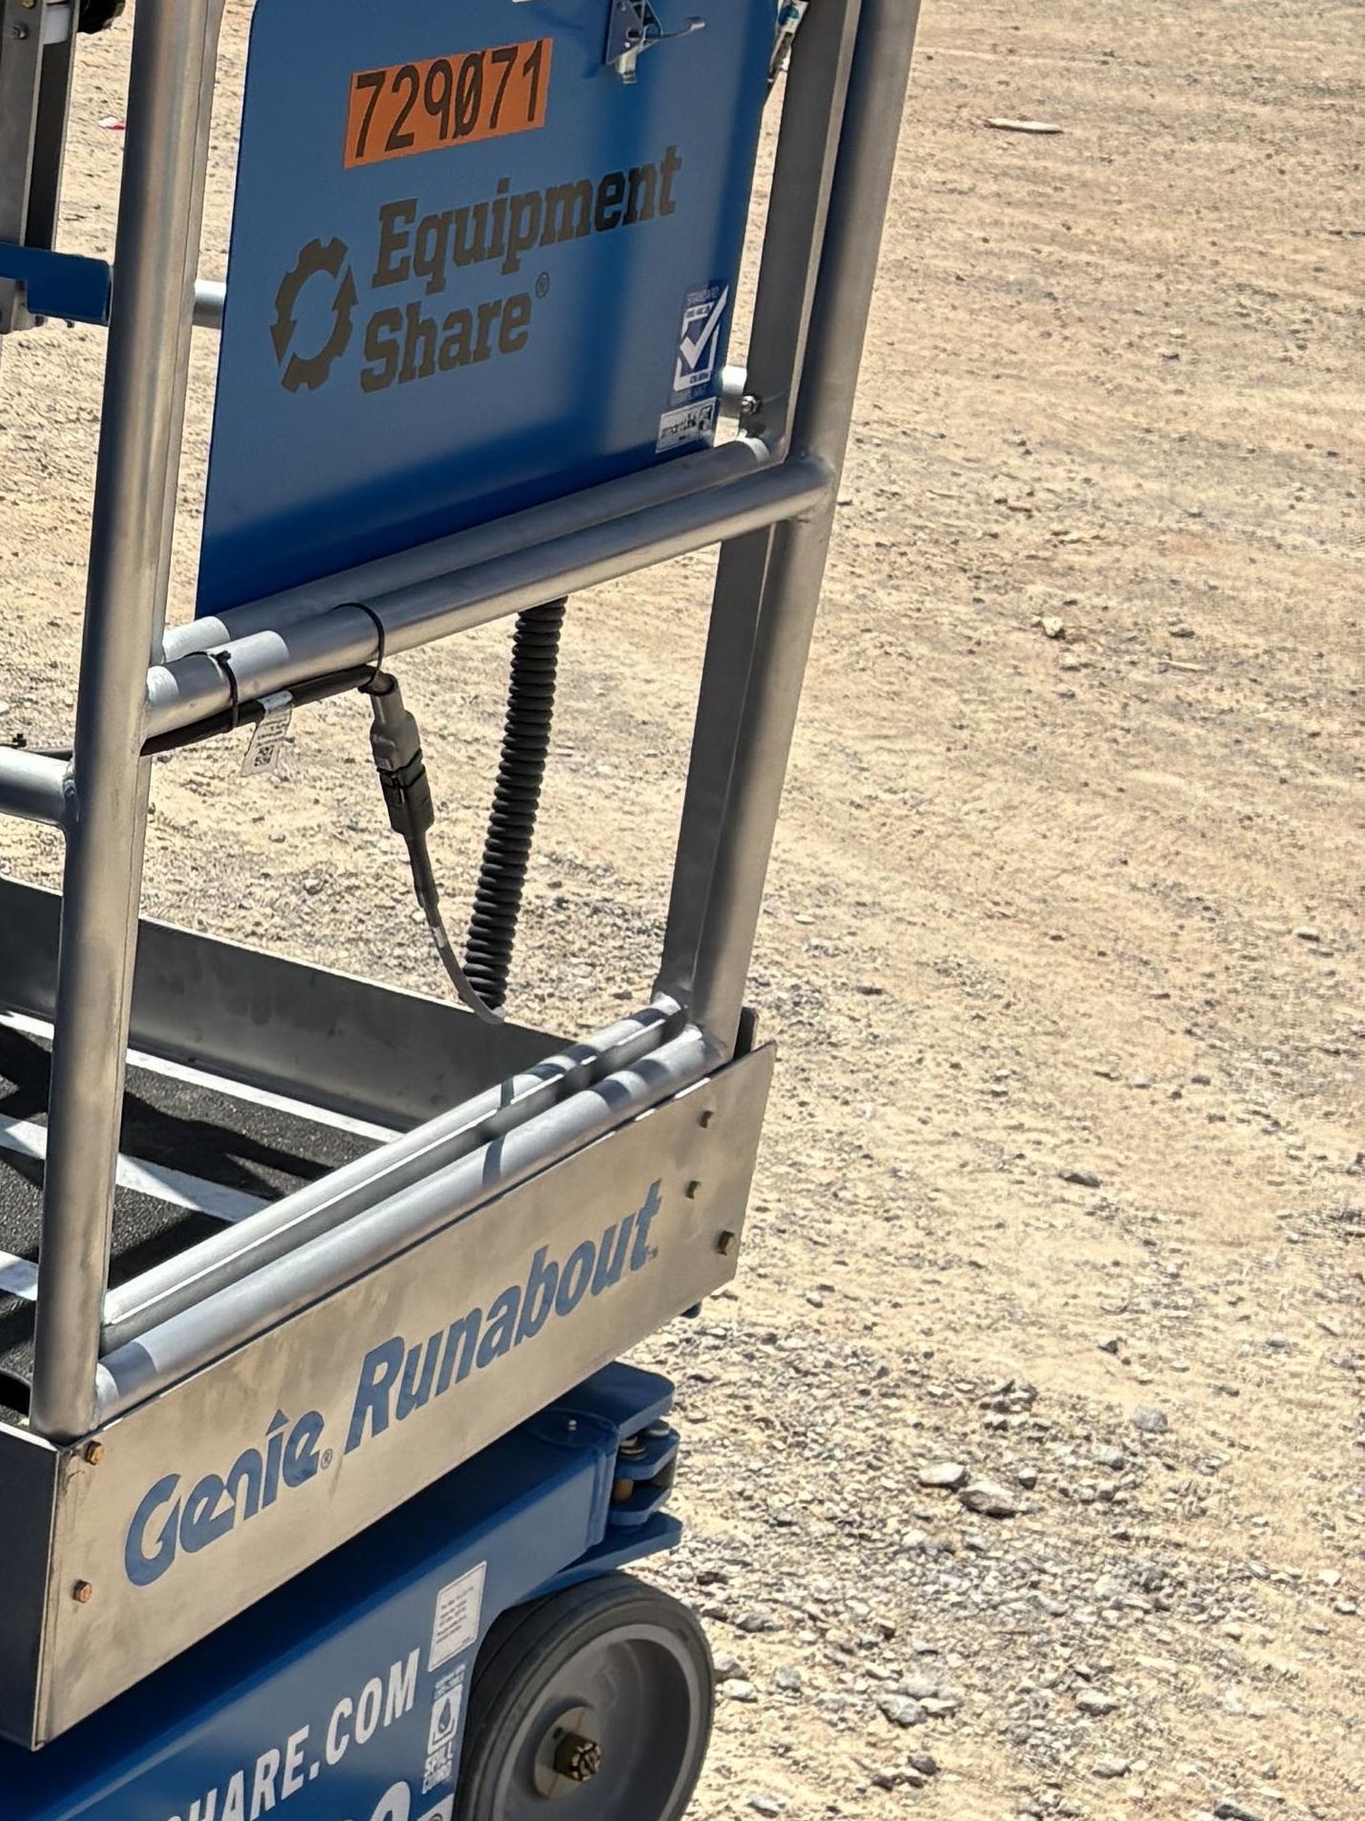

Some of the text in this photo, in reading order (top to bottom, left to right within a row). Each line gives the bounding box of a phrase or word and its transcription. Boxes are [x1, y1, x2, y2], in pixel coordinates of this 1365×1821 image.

[353, 46, 543, 158] 729071
[372, 143, 683, 293] Equipment
[361, 291, 533, 394] Share
[124, 1179, 663, 1588] Genie Runabout
